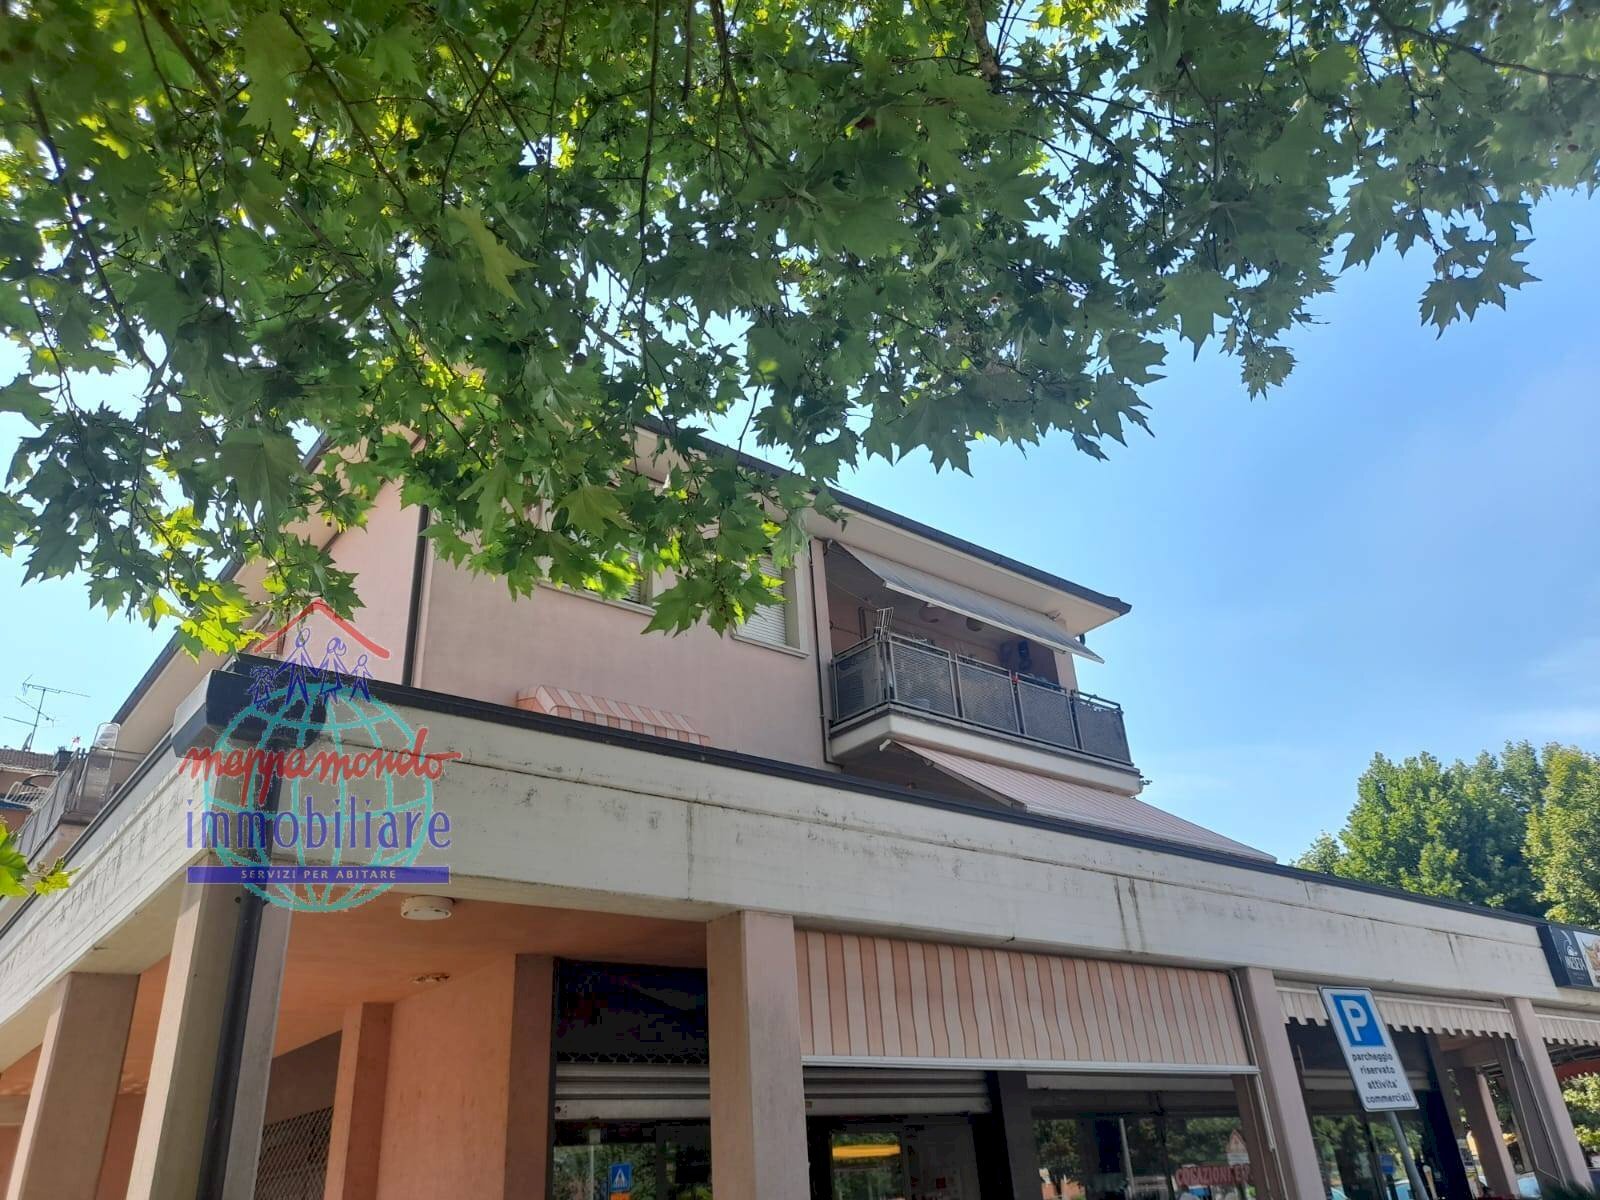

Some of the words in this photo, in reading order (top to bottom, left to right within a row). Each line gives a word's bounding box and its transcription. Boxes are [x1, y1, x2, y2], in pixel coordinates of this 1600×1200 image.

[1340, 999, 1368, 1042] P
[1351, 1052, 1393, 1063] parcheggio
[1360, 1065, 1396, 1075] riservato
[1365, 1092, 1412, 1104] commerciali
